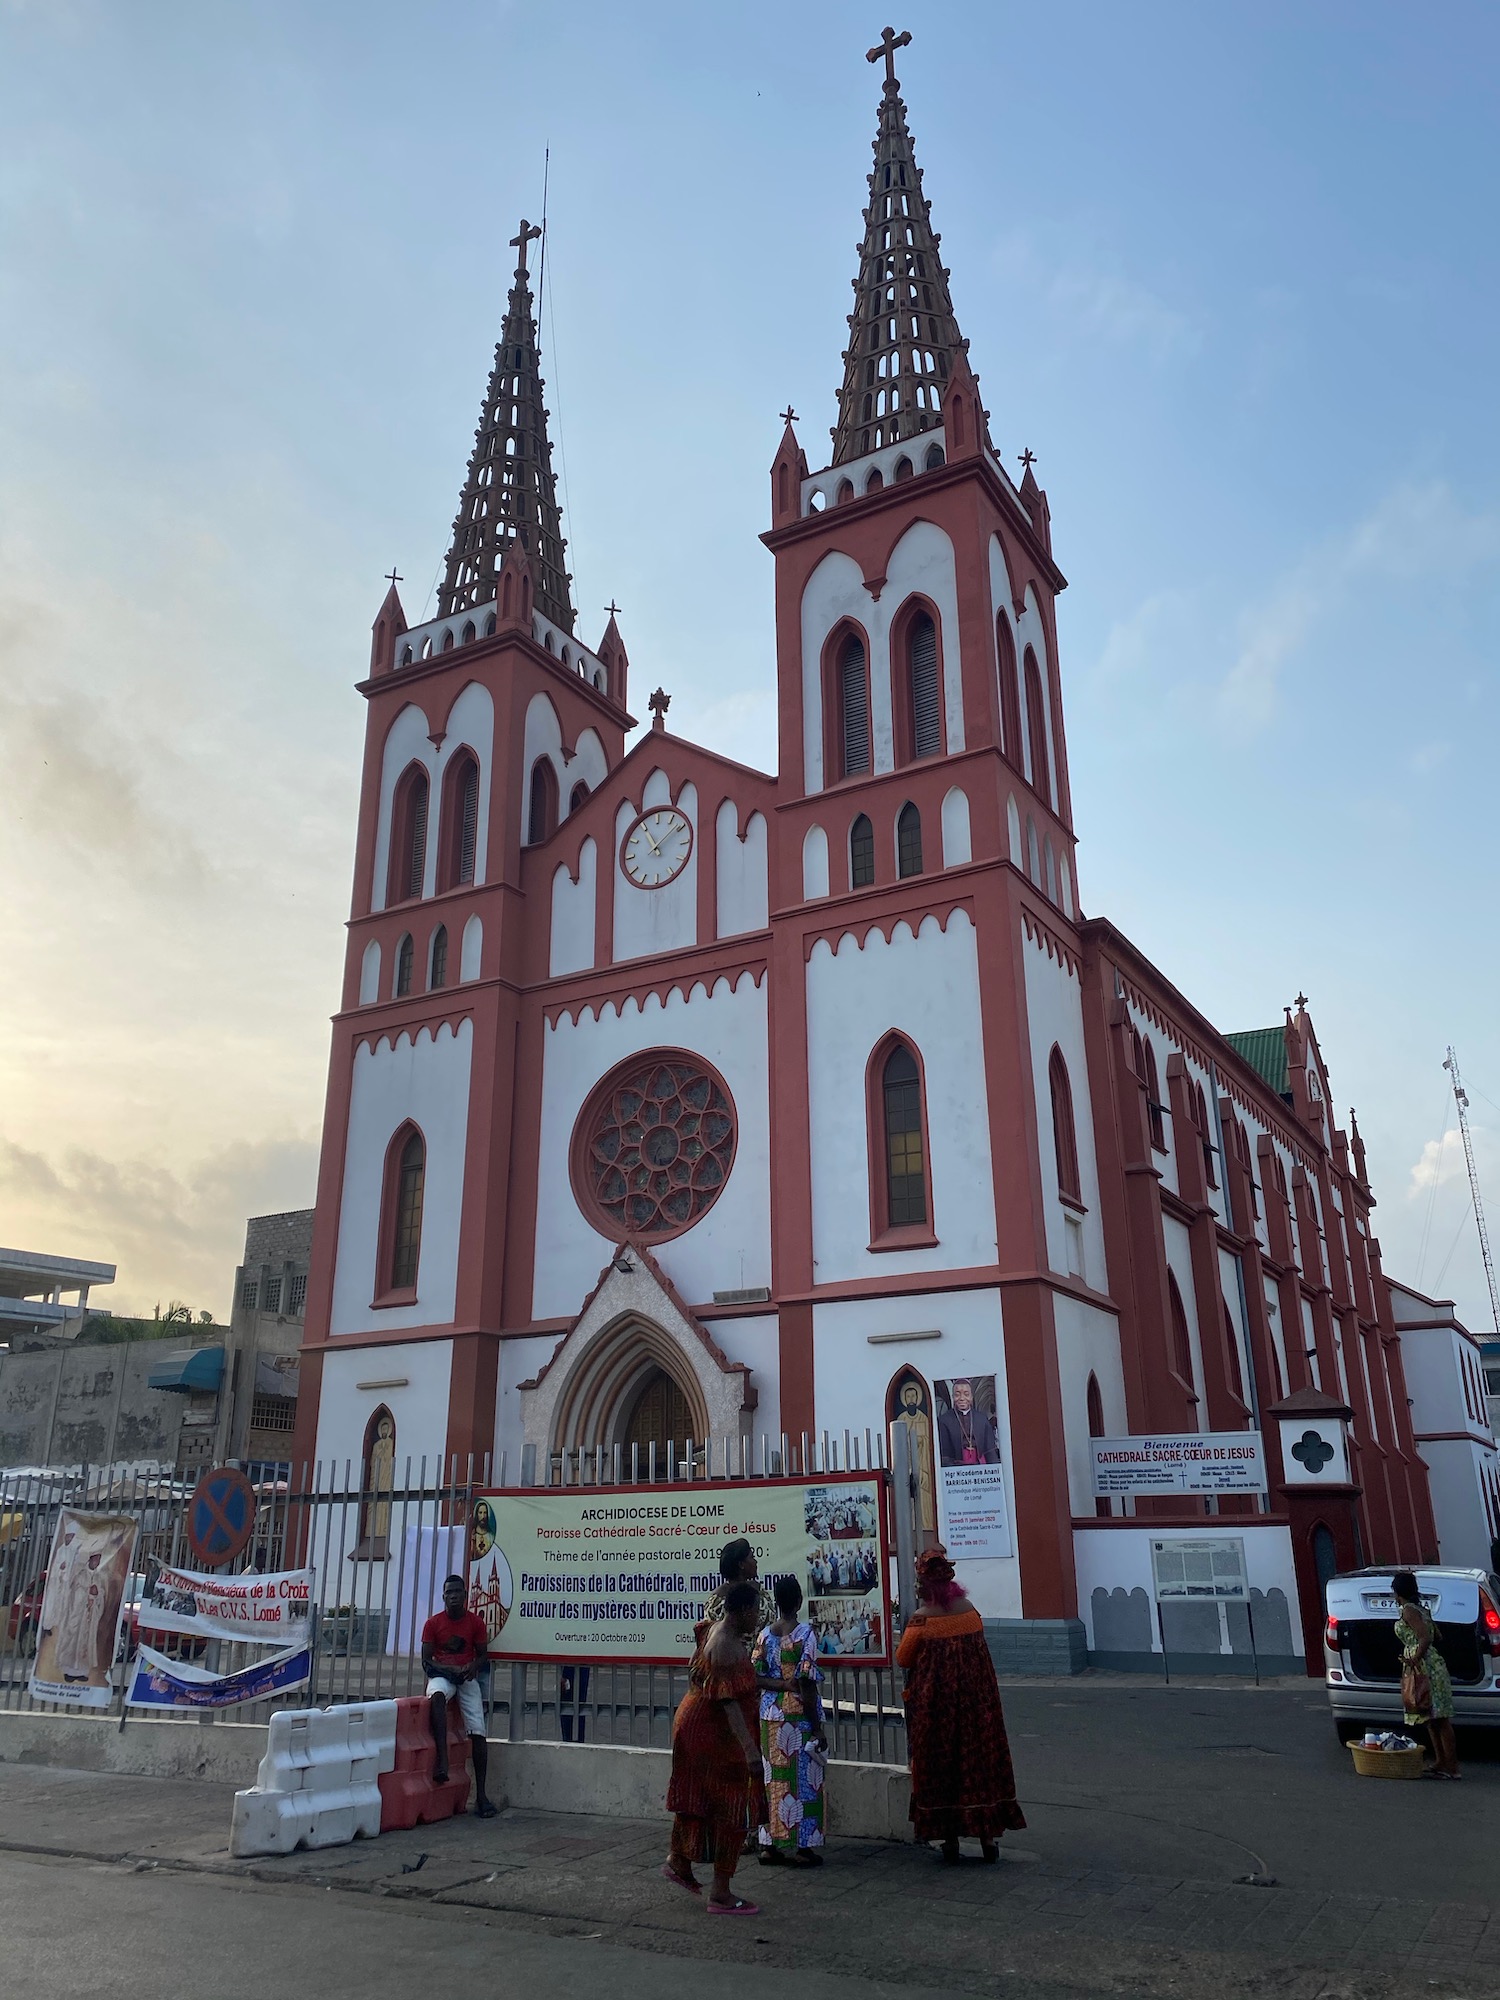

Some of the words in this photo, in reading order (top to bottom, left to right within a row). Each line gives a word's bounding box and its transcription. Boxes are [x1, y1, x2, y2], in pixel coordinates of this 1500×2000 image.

[1144, 1441, 1203, 1450] Bienvenue
[1097, 1450, 1151, 1464] CATHEDRALE
[1213, 1448, 1226, 1460] DE
[1227, 1447, 1255, 1459] JESUS
[944, 1471, 956, 1479] Mgr
[580, 1507, 668, 1521] ARCHIDIOCESE
[671, 1506, 687, 1518] DE
[690, 1505, 725, 1517] LOME
[537, 1527, 581, 1539] Paroisse
[584, 1525, 646, 1538] Cathédrale
[648, 1523, 720, 1537] Sacré-Cœur
[723, 1523, 738, 1534] de
[741, 1522, 776, 1534] Jésus
[543, 1549, 578, 1562] Thème
[580, 1550, 594, 1561] de
[596, 1549, 636, 1561] l'année
[638, 1548, 692, 1563] pastorale
[250, 1581, 263, 1598] de
[265, 1580, 276, 1598] la
[279, 1579, 309, 1599] Croix
[521, 1573, 586, 1593] Paroissiens
[588, 1573, 603, 1593] de
[605, 1573, 616, 1593] la
[618, 1571, 688, 1594] Cathédrale,
[205, 1599, 218, 1617] Les
[219, 1601, 250, 1621] C.V.S.
[253, 1602, 281, 1622] Lomé
[520, 1601, 557, 1618] autour
[559, 1600, 579, 1619] des
[582, 1599, 637, 1621] mystères
[639, 1600, 655, 1620] du
[657, 1600, 695, 1620] Christ
[555, 1632, 587, 1642] Ouverture
[591, 1633, 600, 1642] 20
[600, 1632, 628, 1643] Octobre
[628, 1633, 646, 1643] 2019
